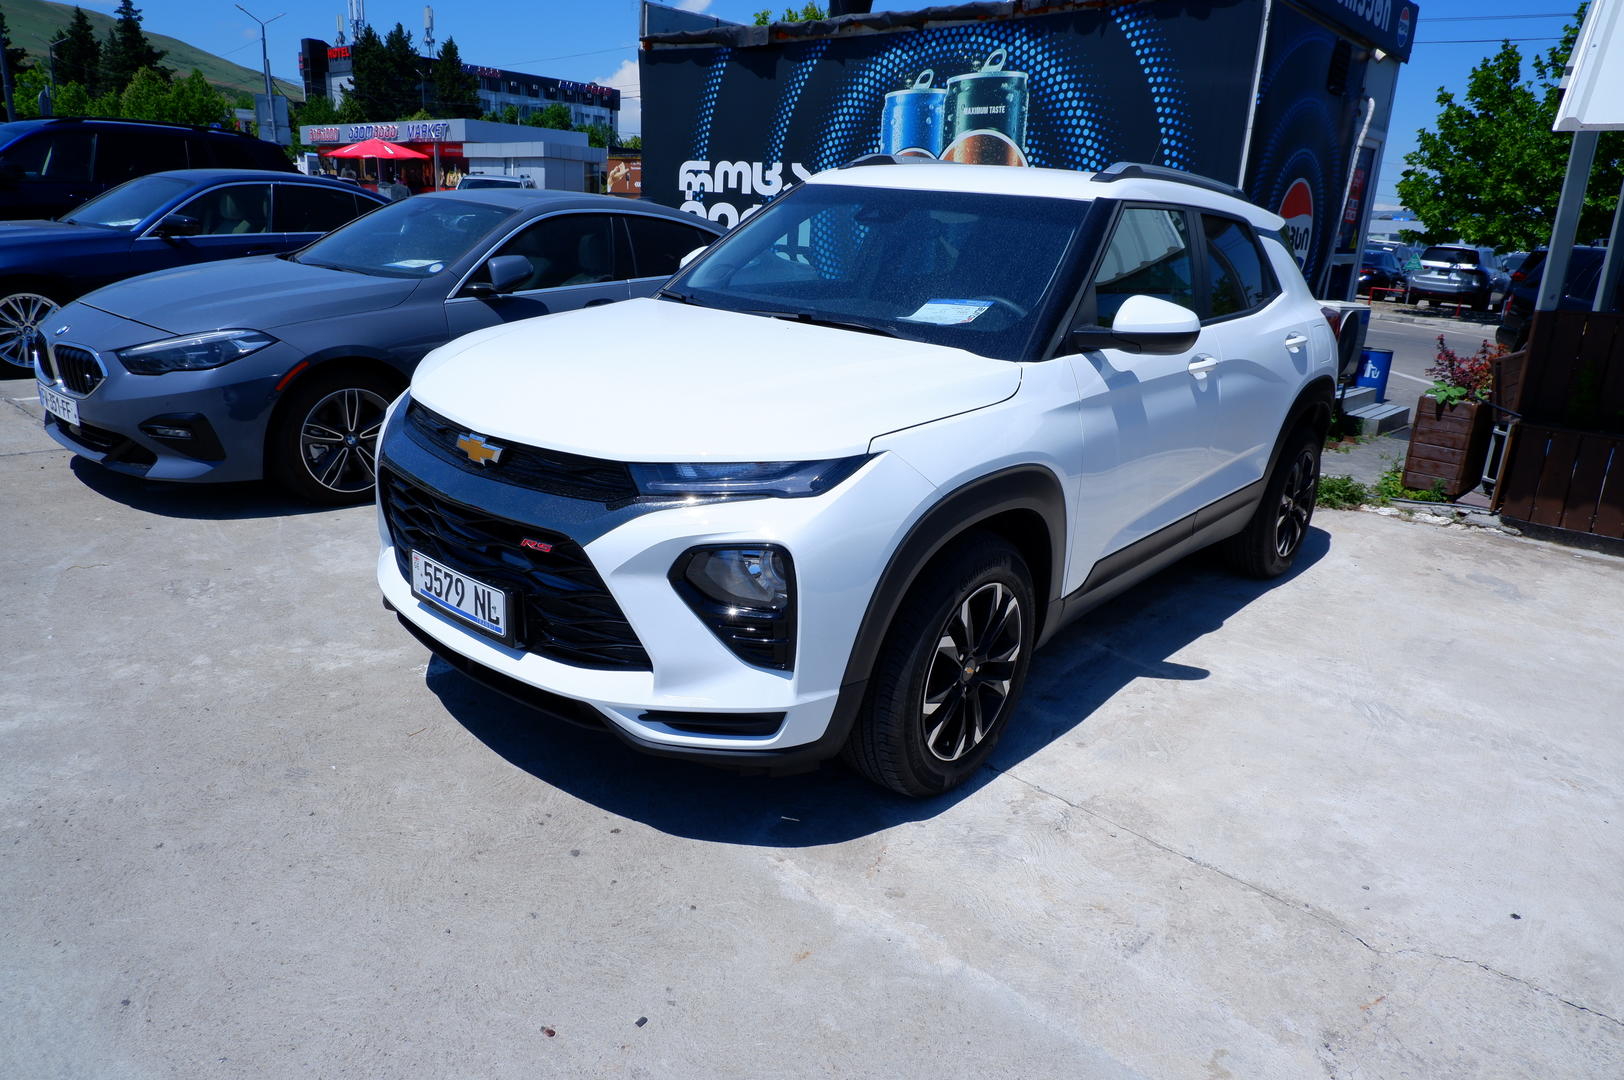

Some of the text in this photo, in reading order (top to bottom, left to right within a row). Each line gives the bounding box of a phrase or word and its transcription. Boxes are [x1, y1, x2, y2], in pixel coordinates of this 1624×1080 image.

[327, 47, 351, 59] HOTEL
[963, 105, 1005, 114] MAXIMUM TASTE
[407, 123, 448, 138] MARKET
[520, 538, 553, 552] RS
[424, 560, 500, 625] 5579 NL
